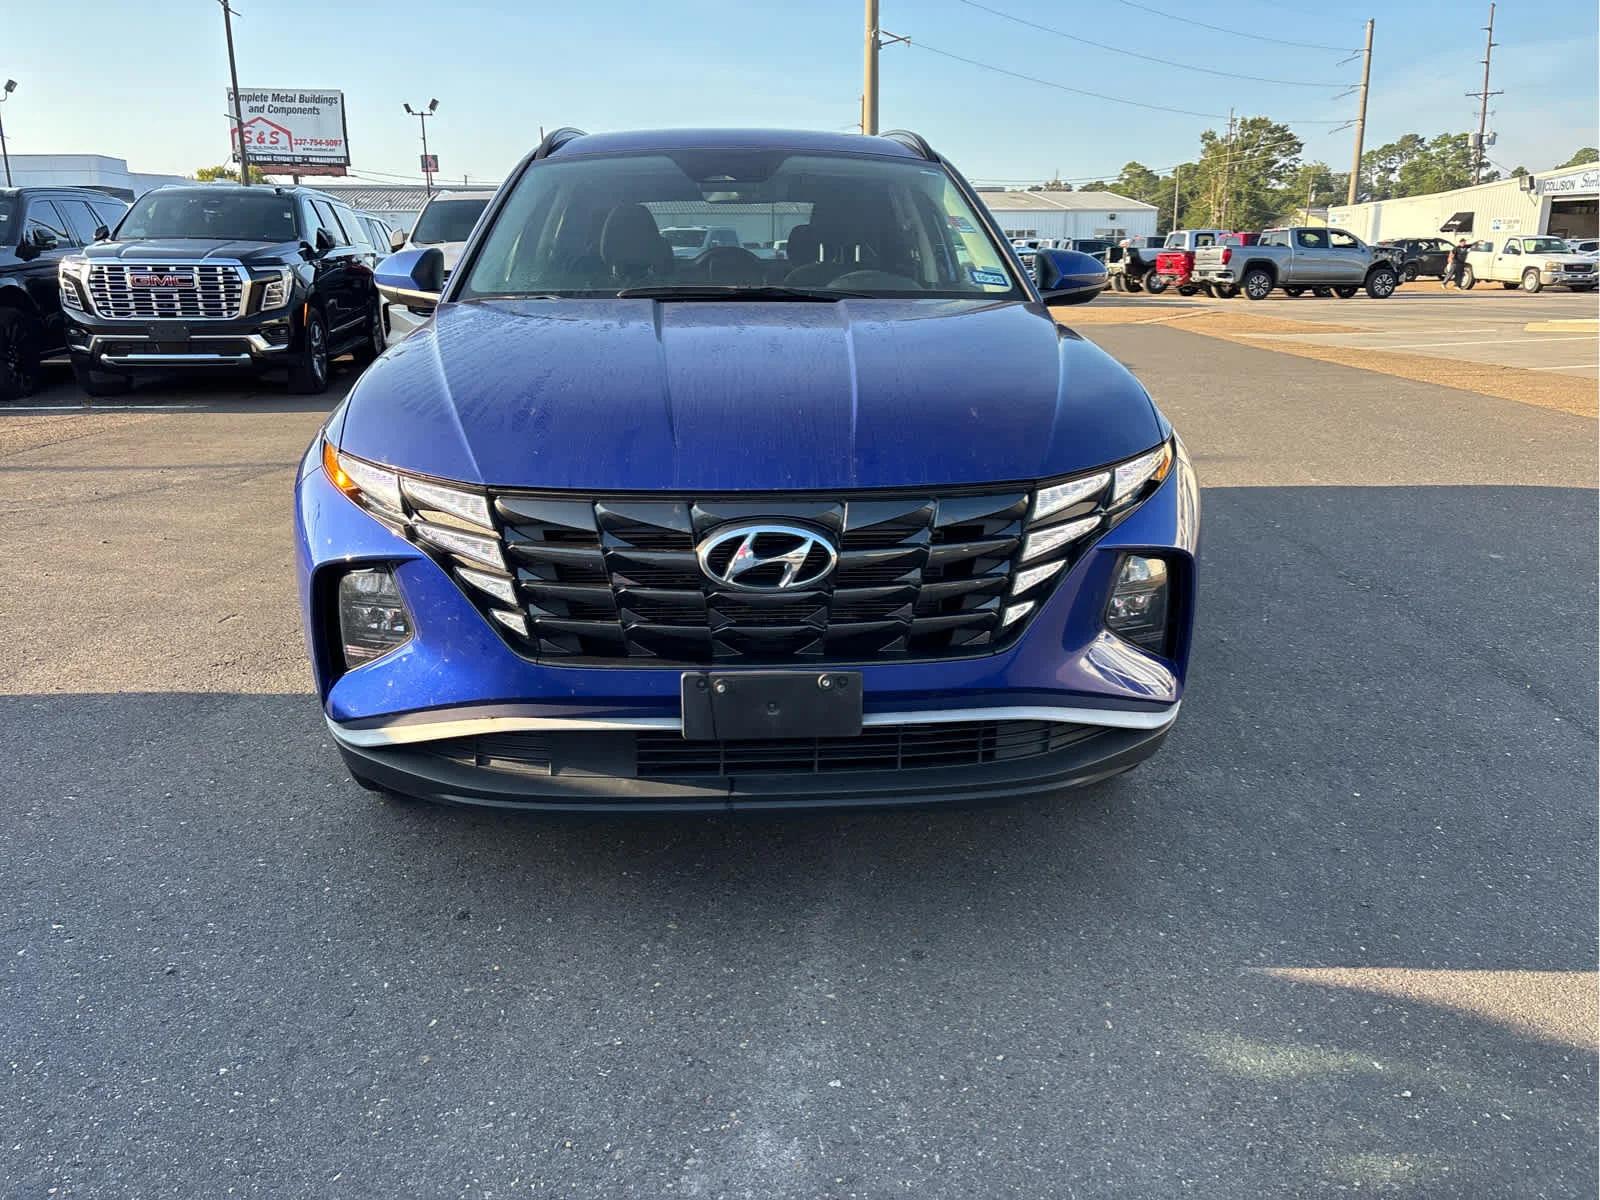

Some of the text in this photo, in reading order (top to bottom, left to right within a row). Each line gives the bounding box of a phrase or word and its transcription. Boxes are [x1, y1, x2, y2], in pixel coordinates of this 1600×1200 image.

[227, 92, 338, 106] Cmplete Metal Buildings
[248, 104, 320, 116] and Components
[243, 131, 280, 144] S & S
[1544, 180, 1576, 191] COLLISION
[131, 274, 193, 286] GMC
